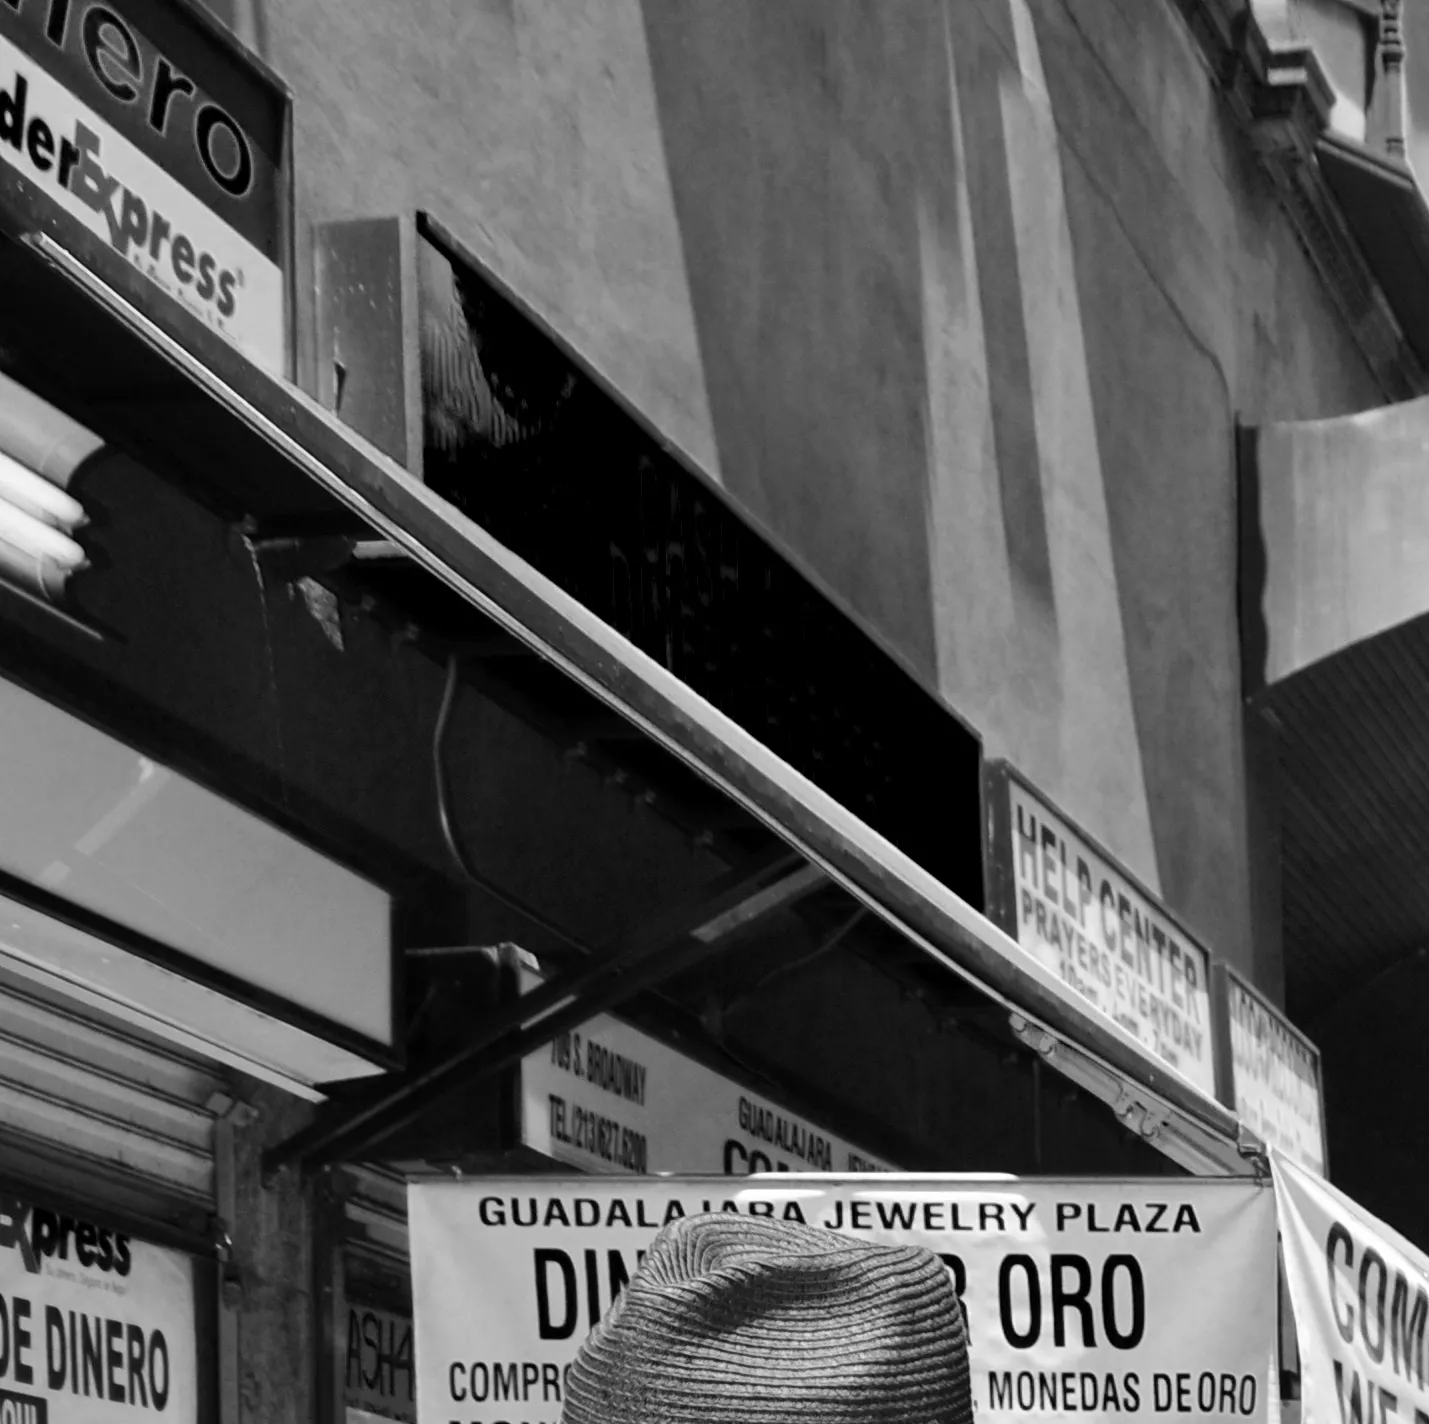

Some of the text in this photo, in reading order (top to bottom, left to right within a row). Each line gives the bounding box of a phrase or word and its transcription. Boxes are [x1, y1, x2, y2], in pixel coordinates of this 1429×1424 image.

[0, 0, 253, 196] ero
[1017, 803, 1092, 929] HELP
[1101, 878, 1202, 1027] CENTER
[1022, 886, 1112, 989] PRAYERS
[587, 1040, 646, 1107] BROADWAY
[738, 1096, 832, 1172] GUADALAJARA
[824, 1201, 1036, 1231] JEWELRY
[1055, 1203, 1202, 1233] PLAZA
[1000, 1253, 1146, 1349] ORO
[45, 1304, 169, 1412] DINERO
[449, 1361, 572, 1402] COMPR
[989, 1371, 1141, 1413] MONEDAS
